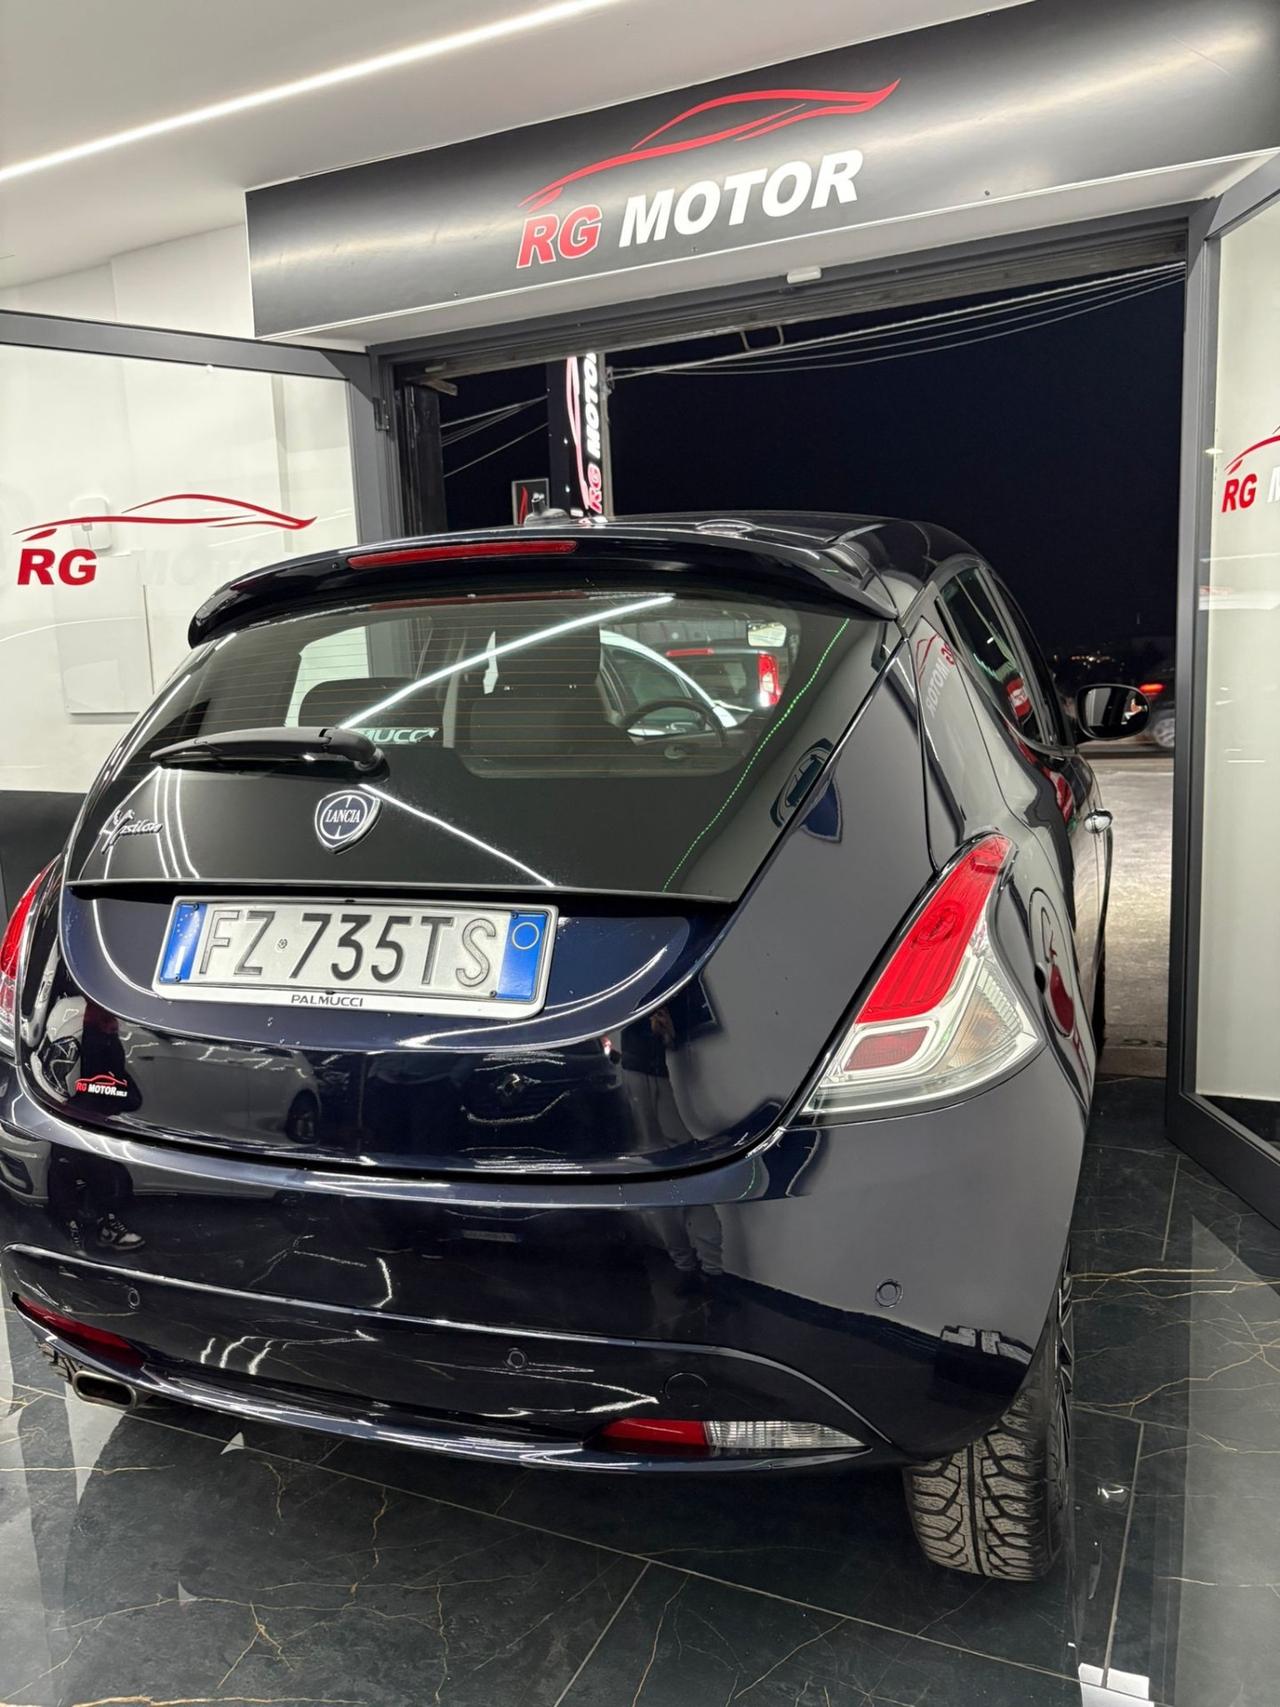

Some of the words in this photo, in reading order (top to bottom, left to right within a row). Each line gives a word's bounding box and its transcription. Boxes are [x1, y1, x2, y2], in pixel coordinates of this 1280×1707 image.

[516, 204, 602, 269] RG
[618, 149, 863, 247] MOTOR
[1222, 474, 1258, 513] RG
[17, 548, 97, 586] RG
[325, 809, 361, 823] LANCIA
[291, 994, 364, 1007] PALMUCCI
[88, 1084, 117, 1096] MOTOR
